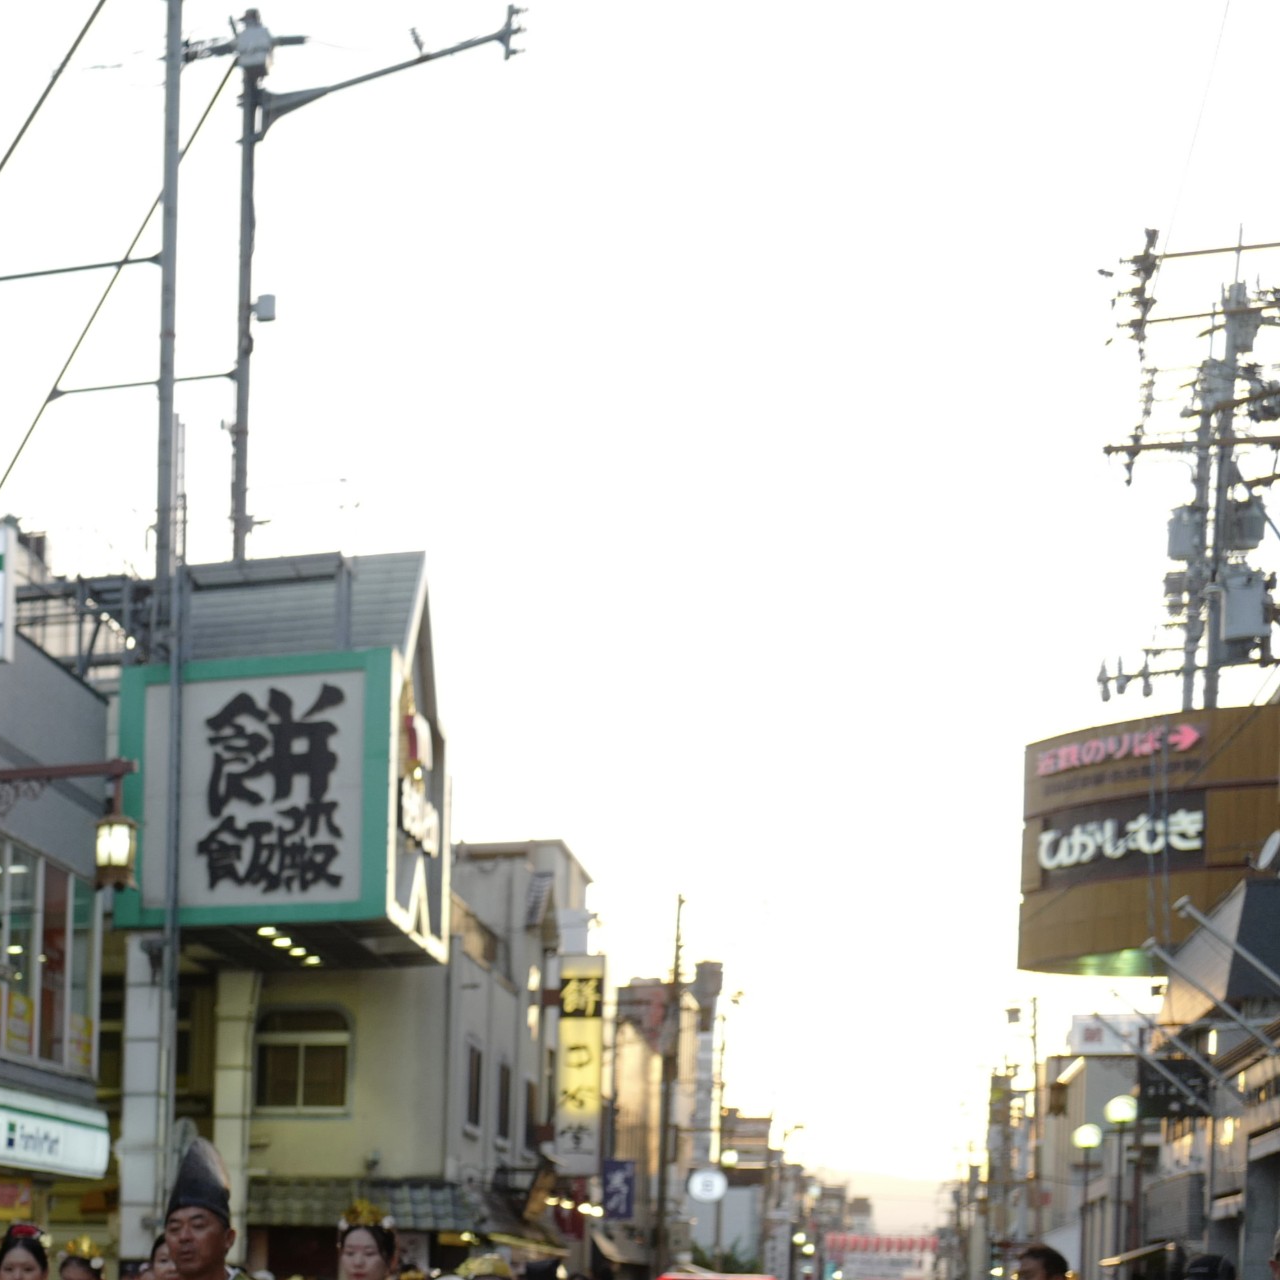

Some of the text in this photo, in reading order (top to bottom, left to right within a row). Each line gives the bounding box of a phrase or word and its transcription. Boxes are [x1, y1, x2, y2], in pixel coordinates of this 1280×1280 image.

[1038, 808, 1205, 870] ひがしむき
